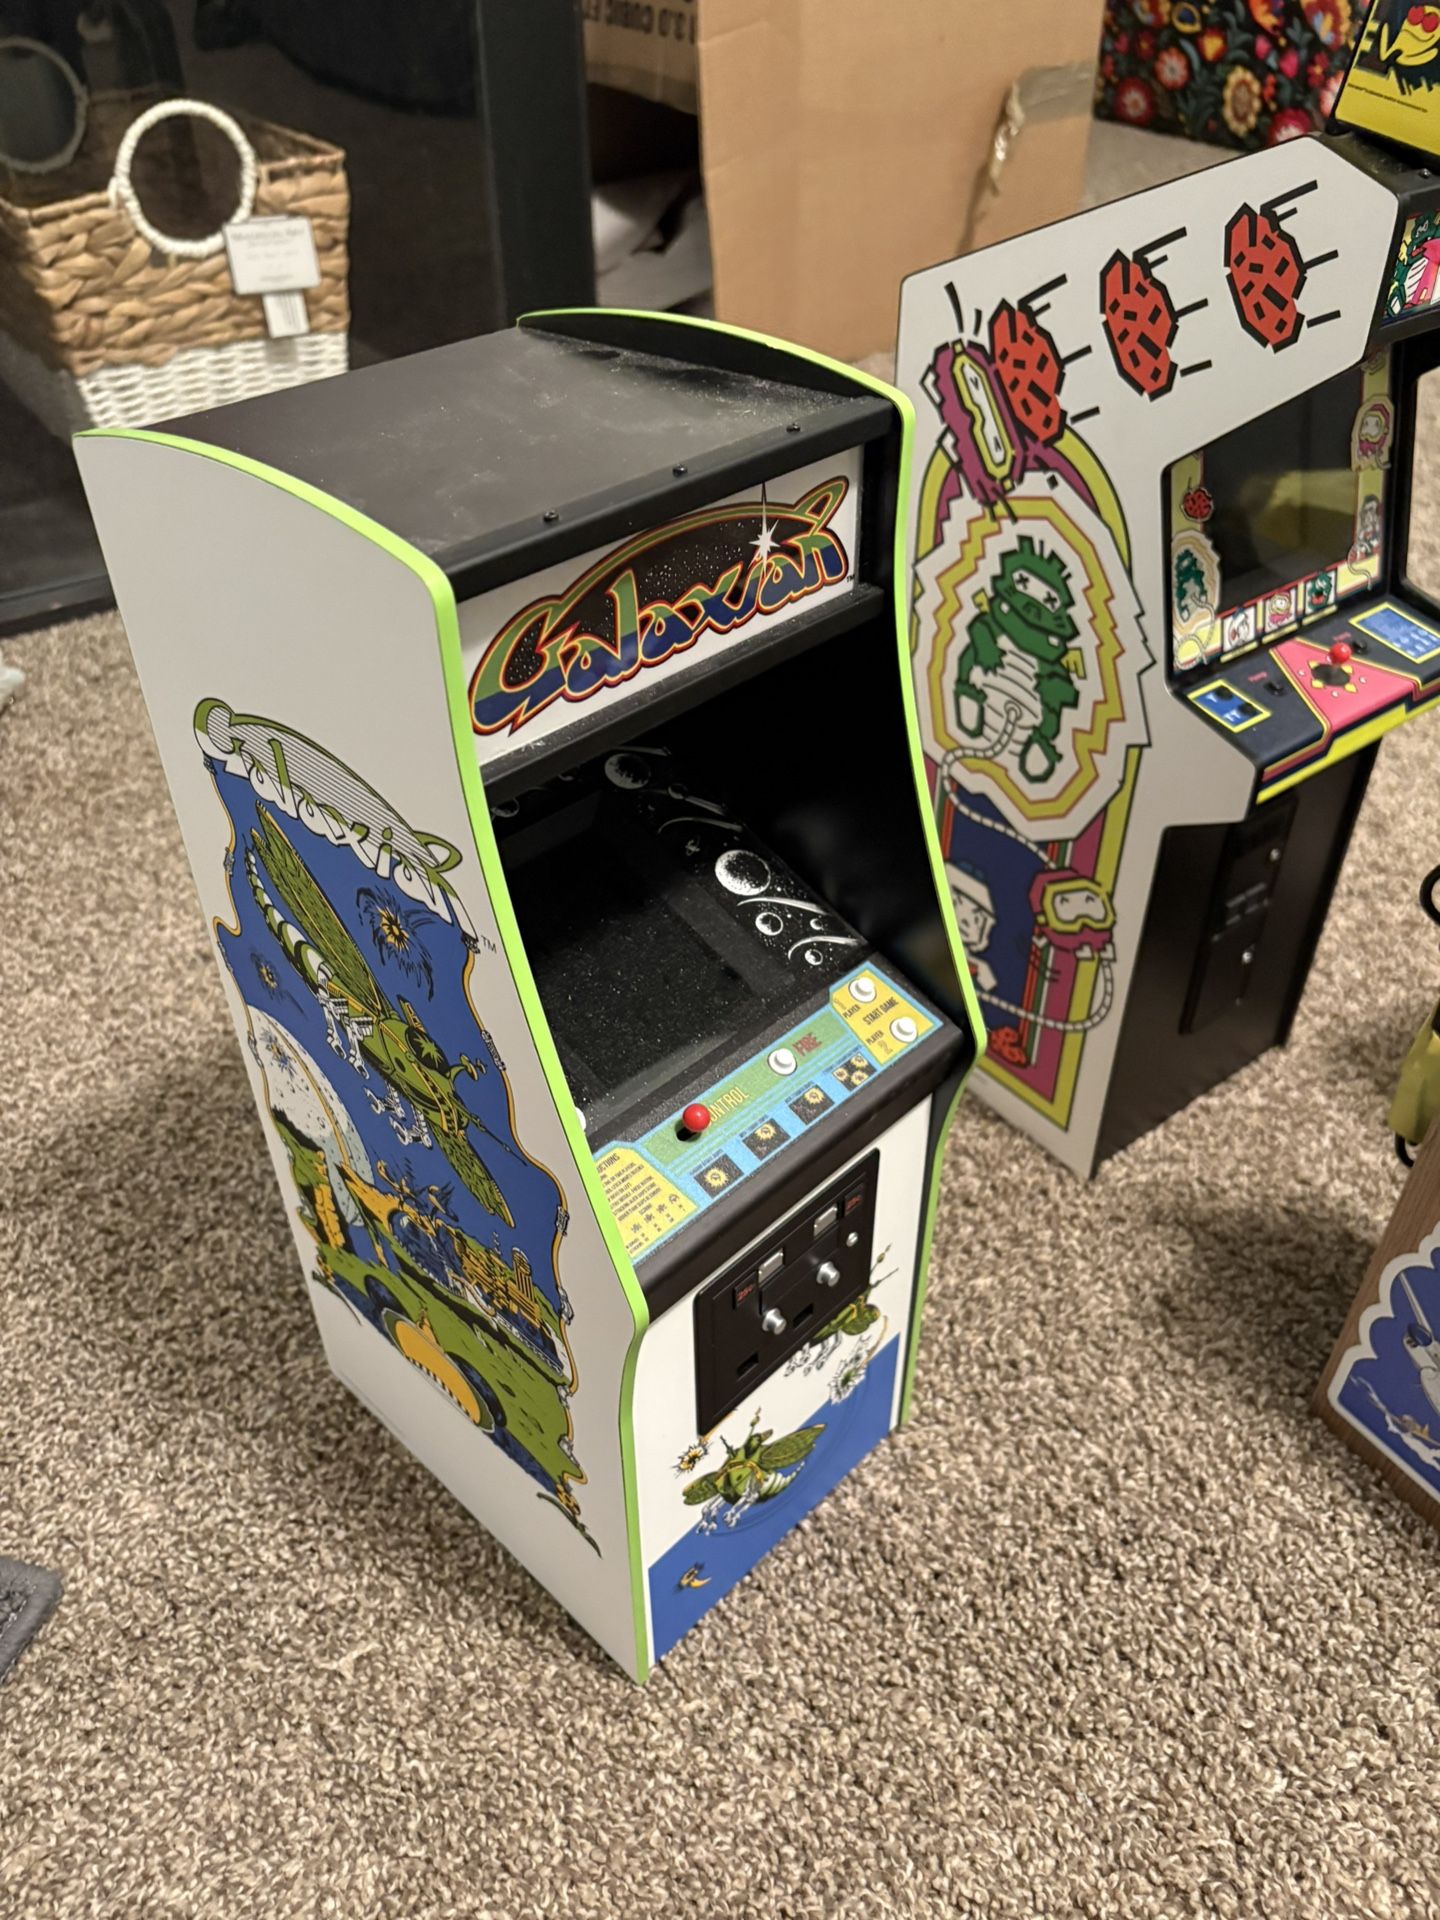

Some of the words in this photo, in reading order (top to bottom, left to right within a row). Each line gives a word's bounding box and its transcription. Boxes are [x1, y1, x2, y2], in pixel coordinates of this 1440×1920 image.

[468, 475, 849, 736] Galaxian
[193, 697, 479, 942] Galaxian
[843, 1004, 861, 1019] PLAYER
[862, 1007, 882, 1025] START
[879, 996, 899, 1014] GAME
[792, 1032, 822, 1057] FIRE
[866, 1030, 884, 1045] PLAYER
[709, 1086, 749, 1122] ONTROL
